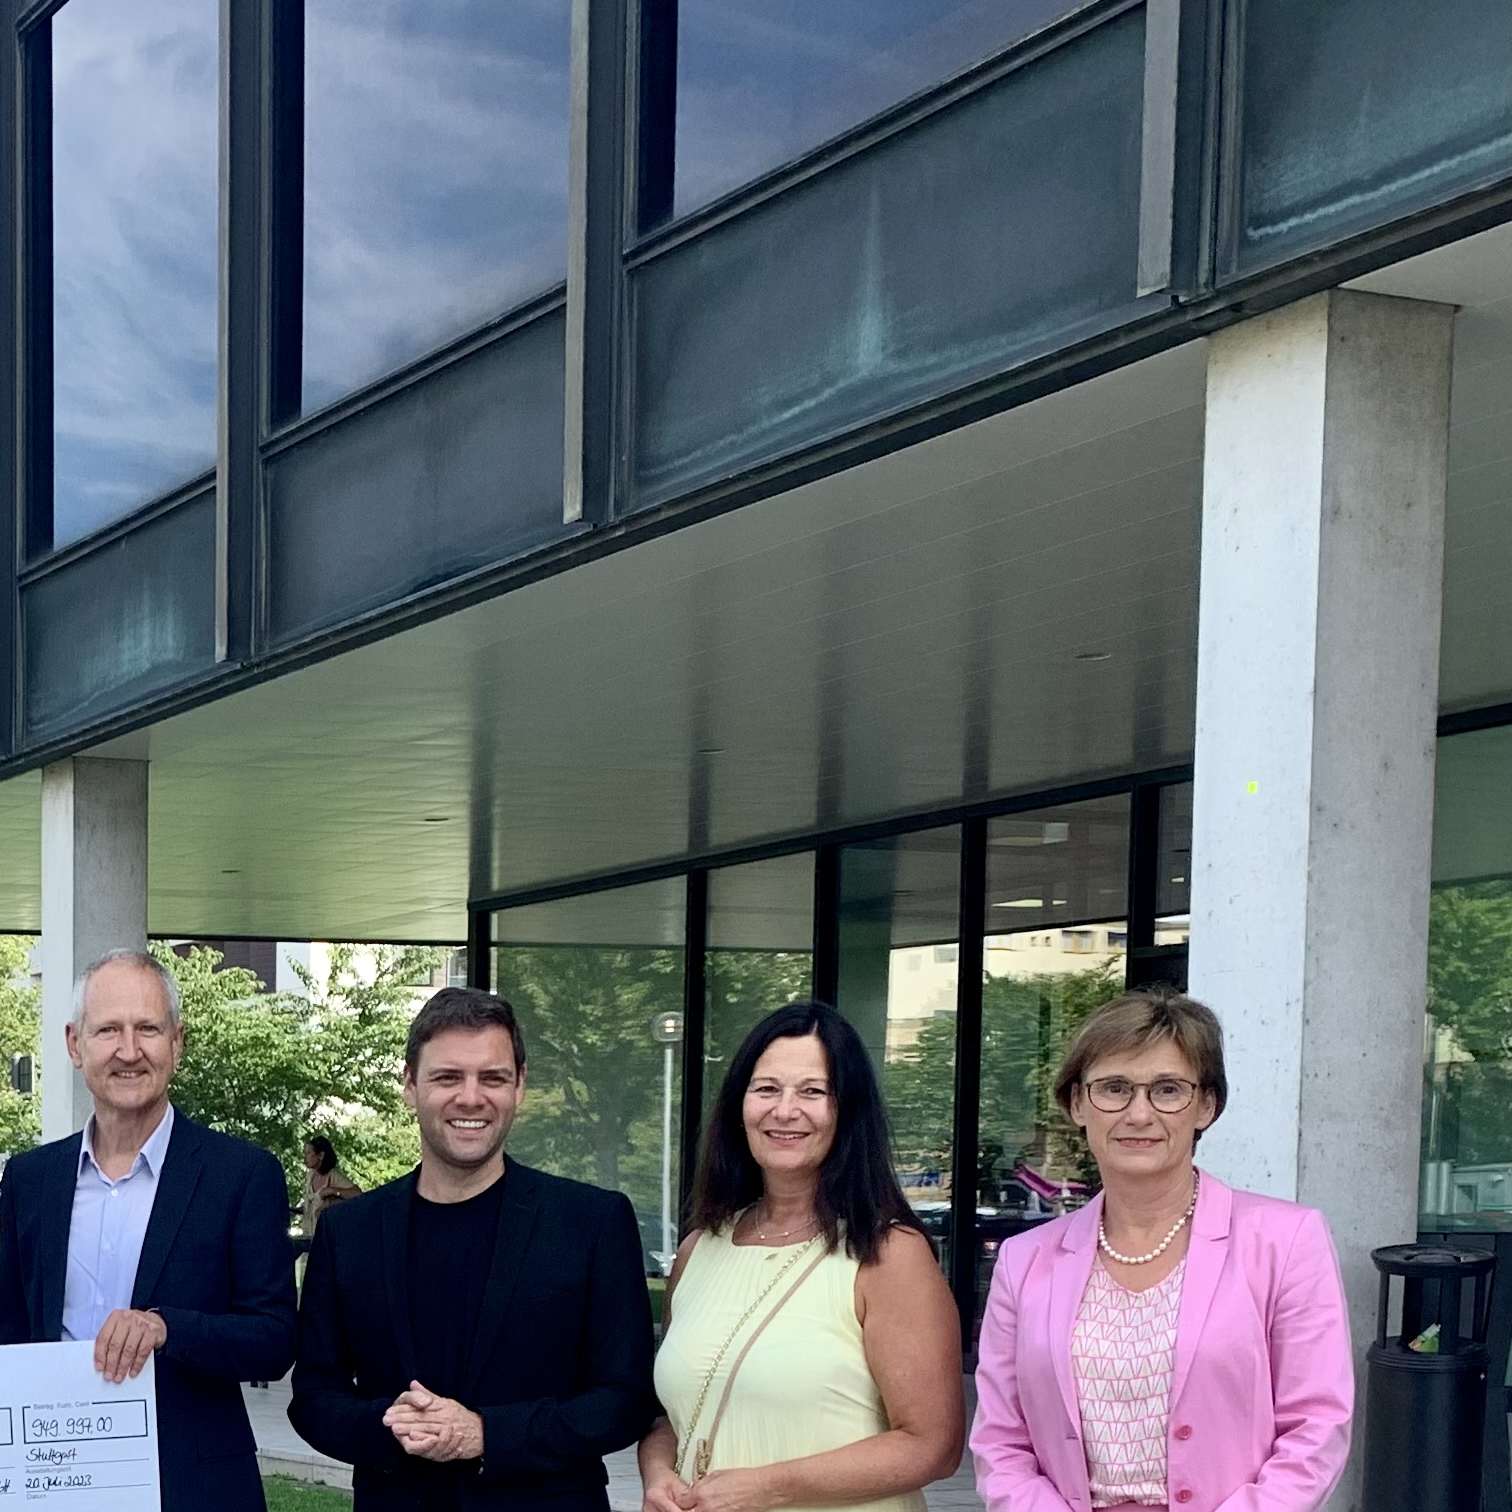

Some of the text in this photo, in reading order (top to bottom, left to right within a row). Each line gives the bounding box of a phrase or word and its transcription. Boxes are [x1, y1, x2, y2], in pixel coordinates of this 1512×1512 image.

[25, 1447, 77, 1465] Stuttgart
[25, 1466, 72, 1475] Ausstellungsort
[42, 1476, 62, 1491] Juli
[64, 1474, 92, 1487] 2023
[26, 1493, 47, 1501] Datum
